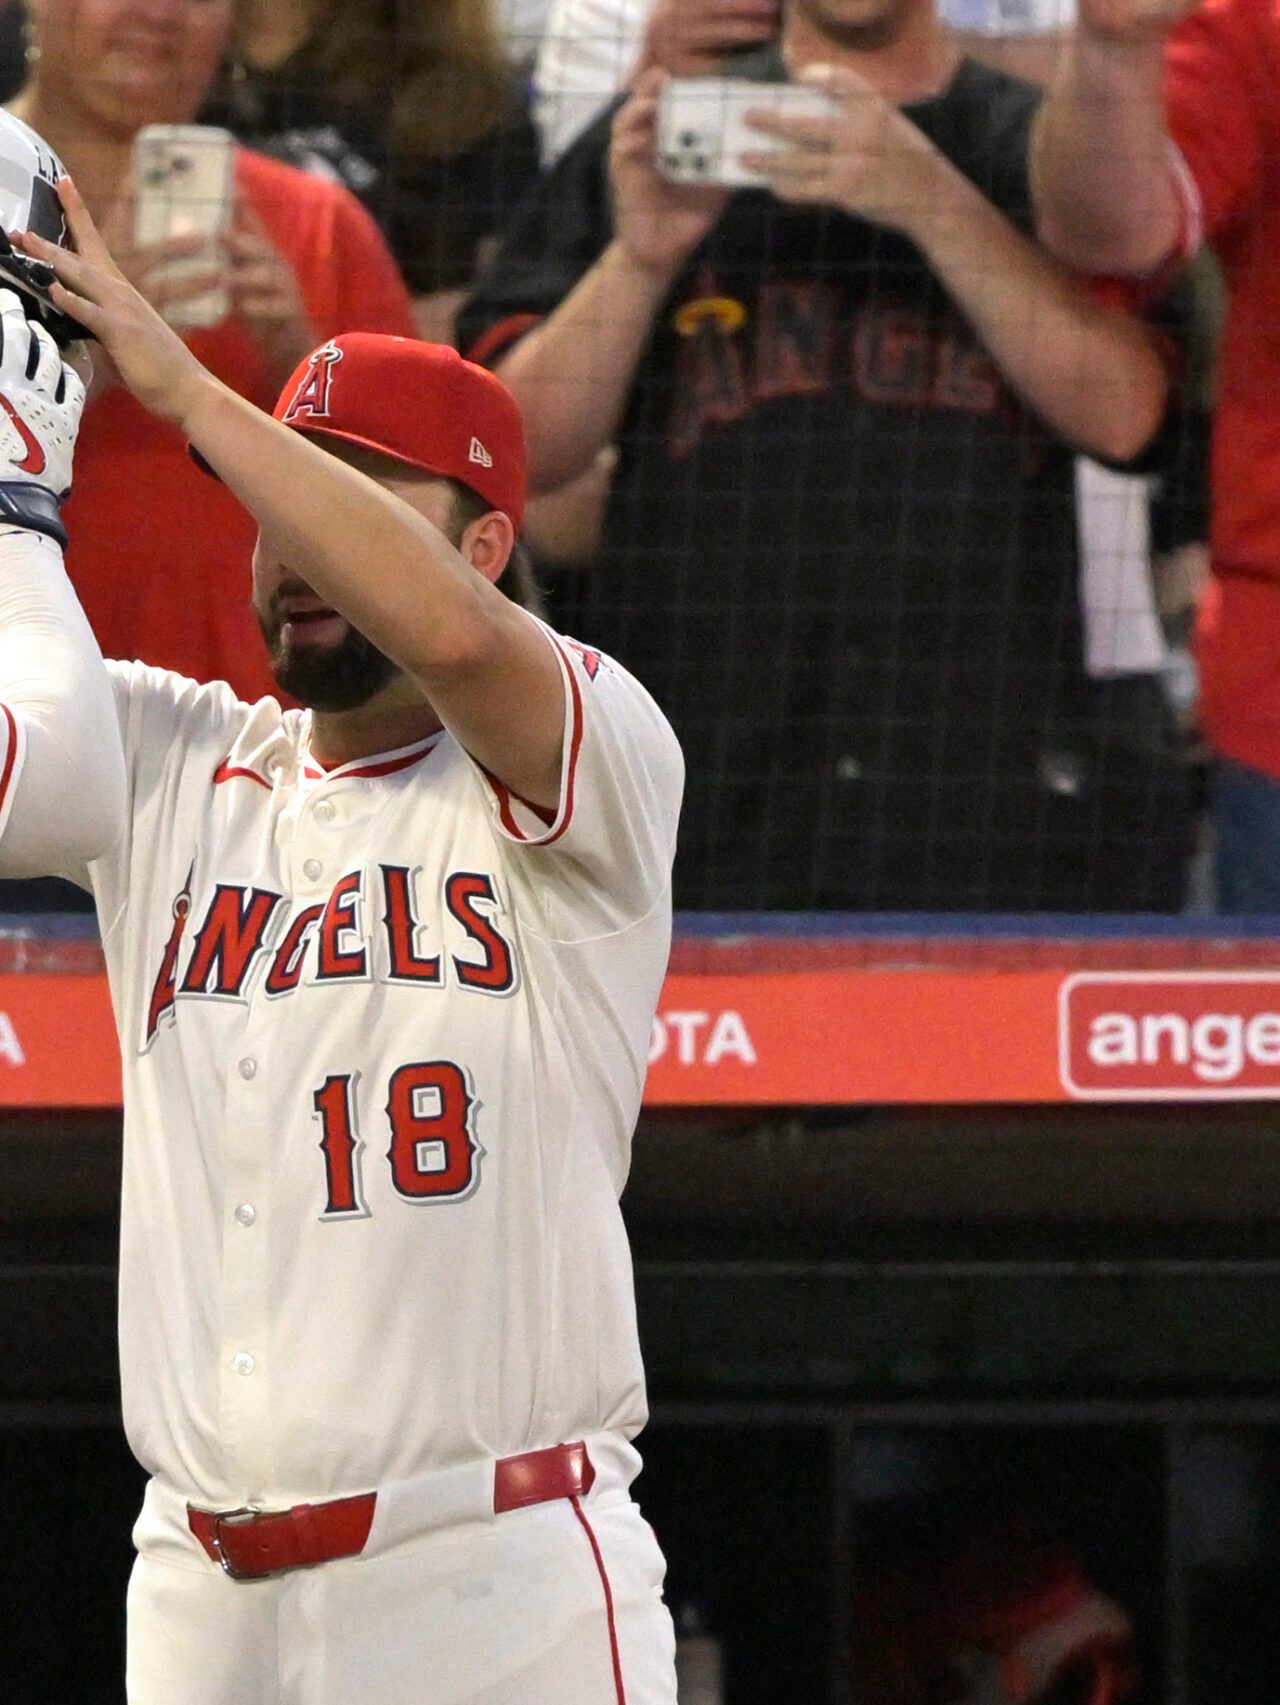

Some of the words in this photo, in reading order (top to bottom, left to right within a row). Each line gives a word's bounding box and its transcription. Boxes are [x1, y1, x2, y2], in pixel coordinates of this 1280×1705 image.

[282, 340, 343, 422] A
[139, 857, 520, 1052] ANGELS
[312, 1059, 490, 1222] 18
